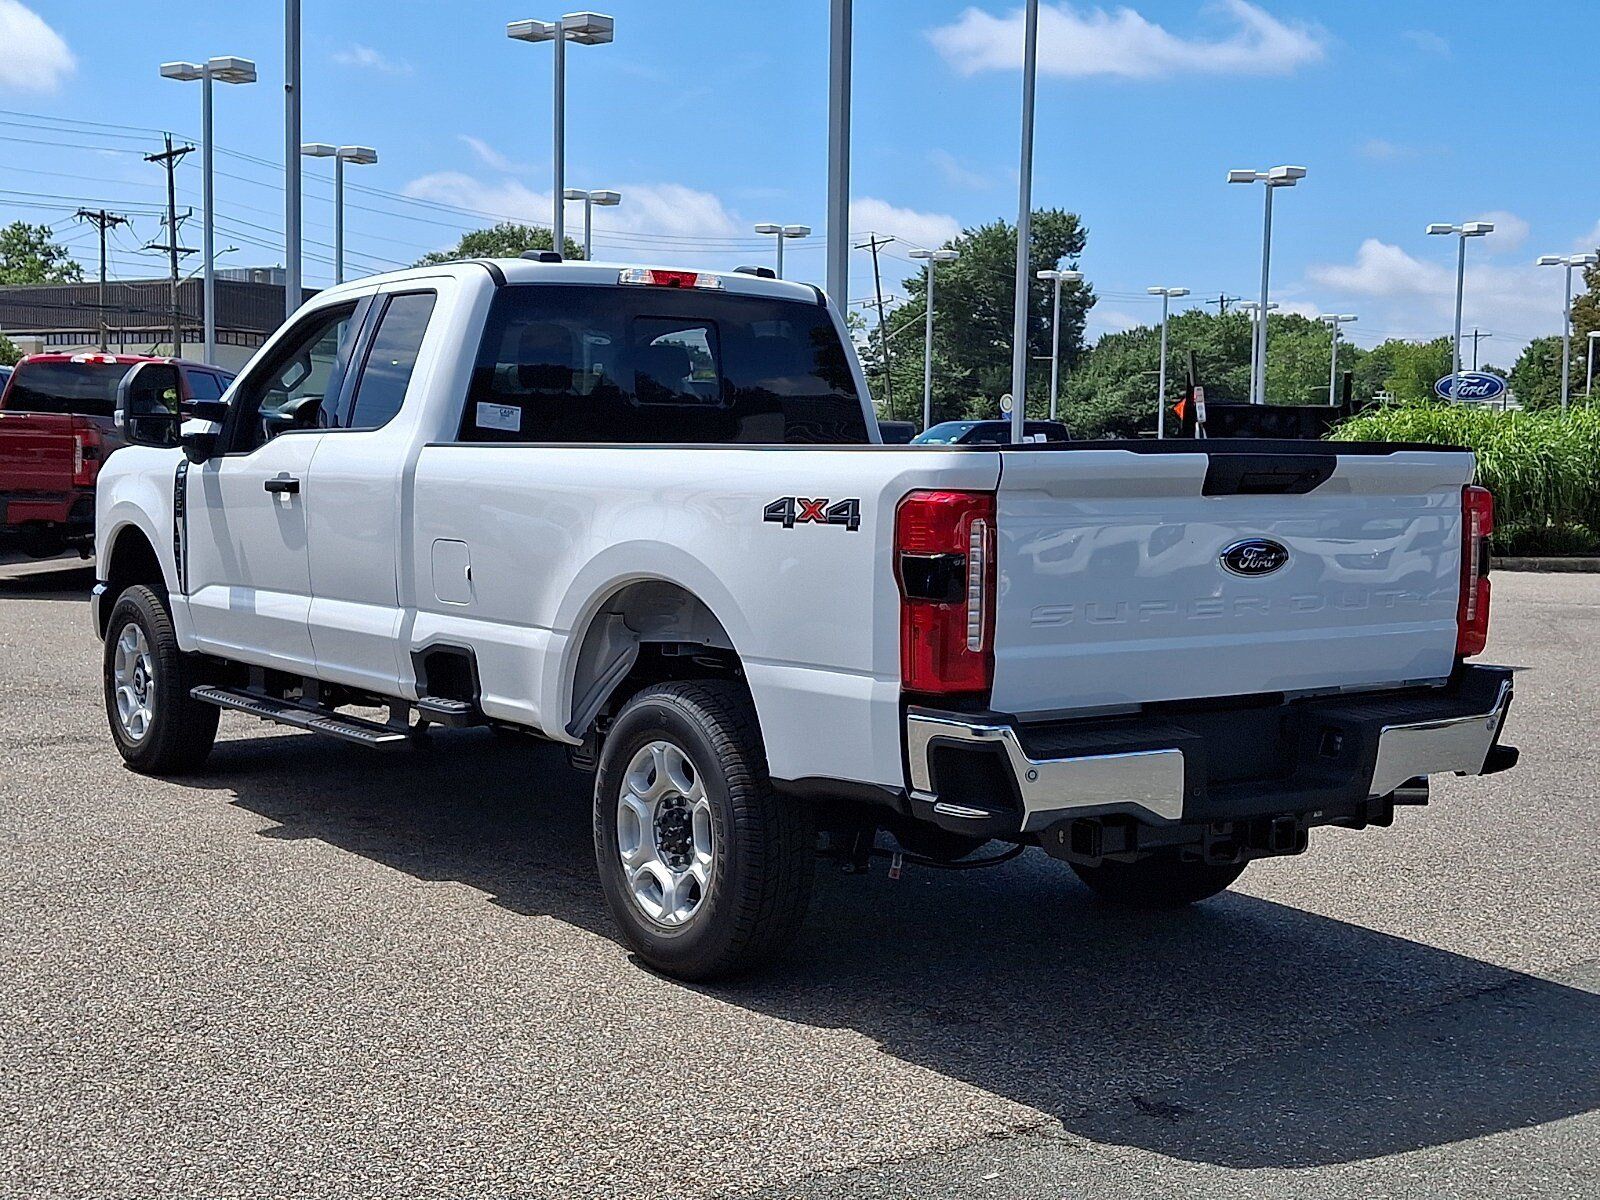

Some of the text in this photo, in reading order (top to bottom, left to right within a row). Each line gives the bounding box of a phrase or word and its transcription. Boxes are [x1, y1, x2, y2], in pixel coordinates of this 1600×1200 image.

[1448, 377, 1491, 396] Ford
[1238, 546, 1276, 569] Ford
[1030, 588, 1442, 628] SUPER DUTY
